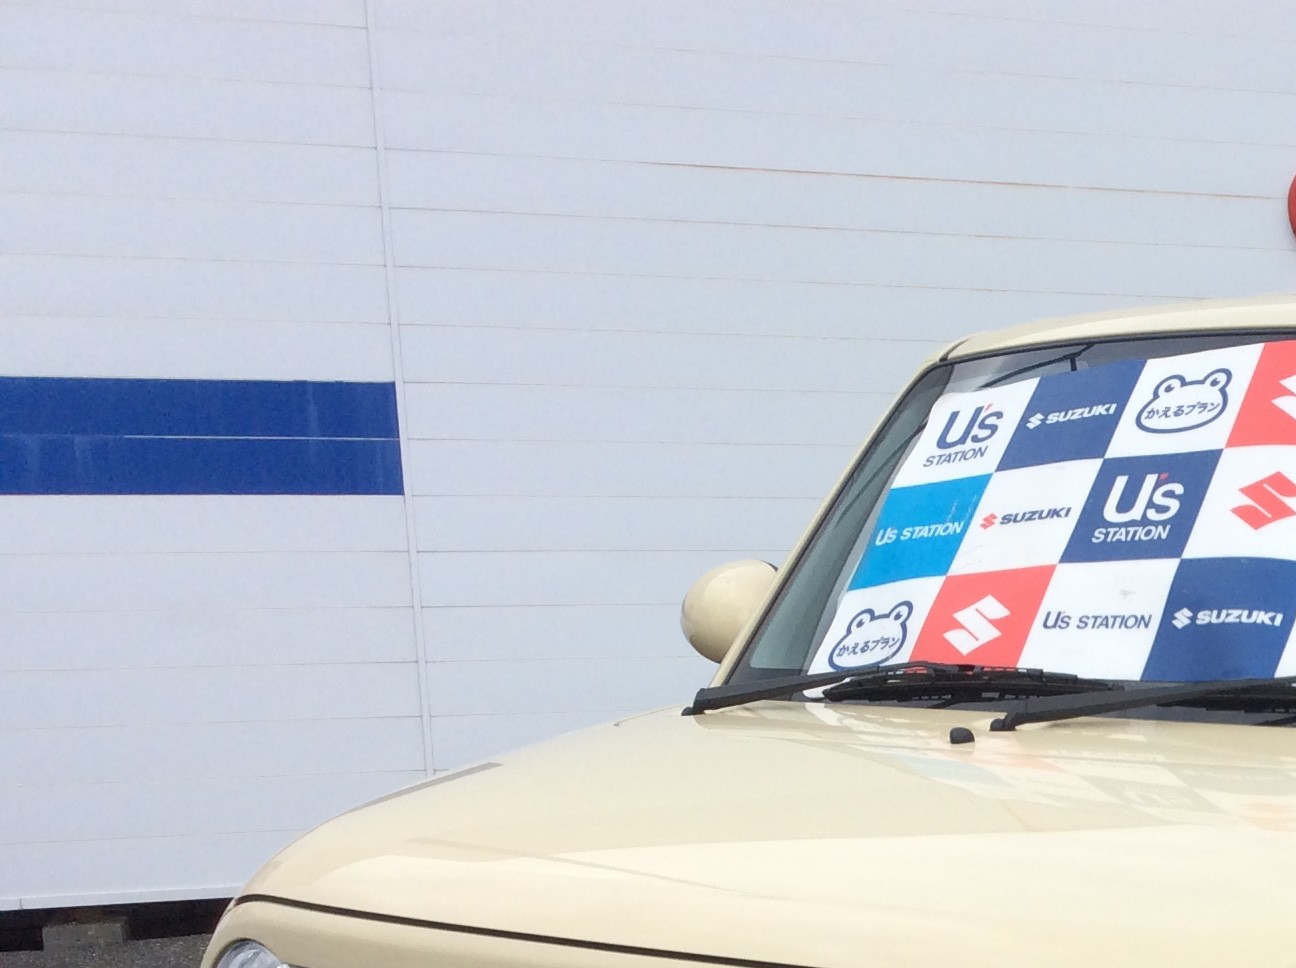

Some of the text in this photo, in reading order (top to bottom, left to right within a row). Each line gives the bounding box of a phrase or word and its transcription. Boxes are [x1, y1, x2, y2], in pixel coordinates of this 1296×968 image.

[1045, 403, 1117, 425] SUZUKI
[1144, 400, 1221, 421] かえるプラン
[936, 404, 1004, 450] U's
[922, 446, 988, 468] STATION
[1103, 472, 1185, 523] U's
[1000, 507, 1072, 526] SUZUKI
[900, 521, 965, 541] STATION
[1091, 524, 1170, 544] STATION
[1076, 614, 1152, 630] STATION
[1196, 610, 1284, 628] SUZUKI
[837, 636, 900, 657] かえるプラン
